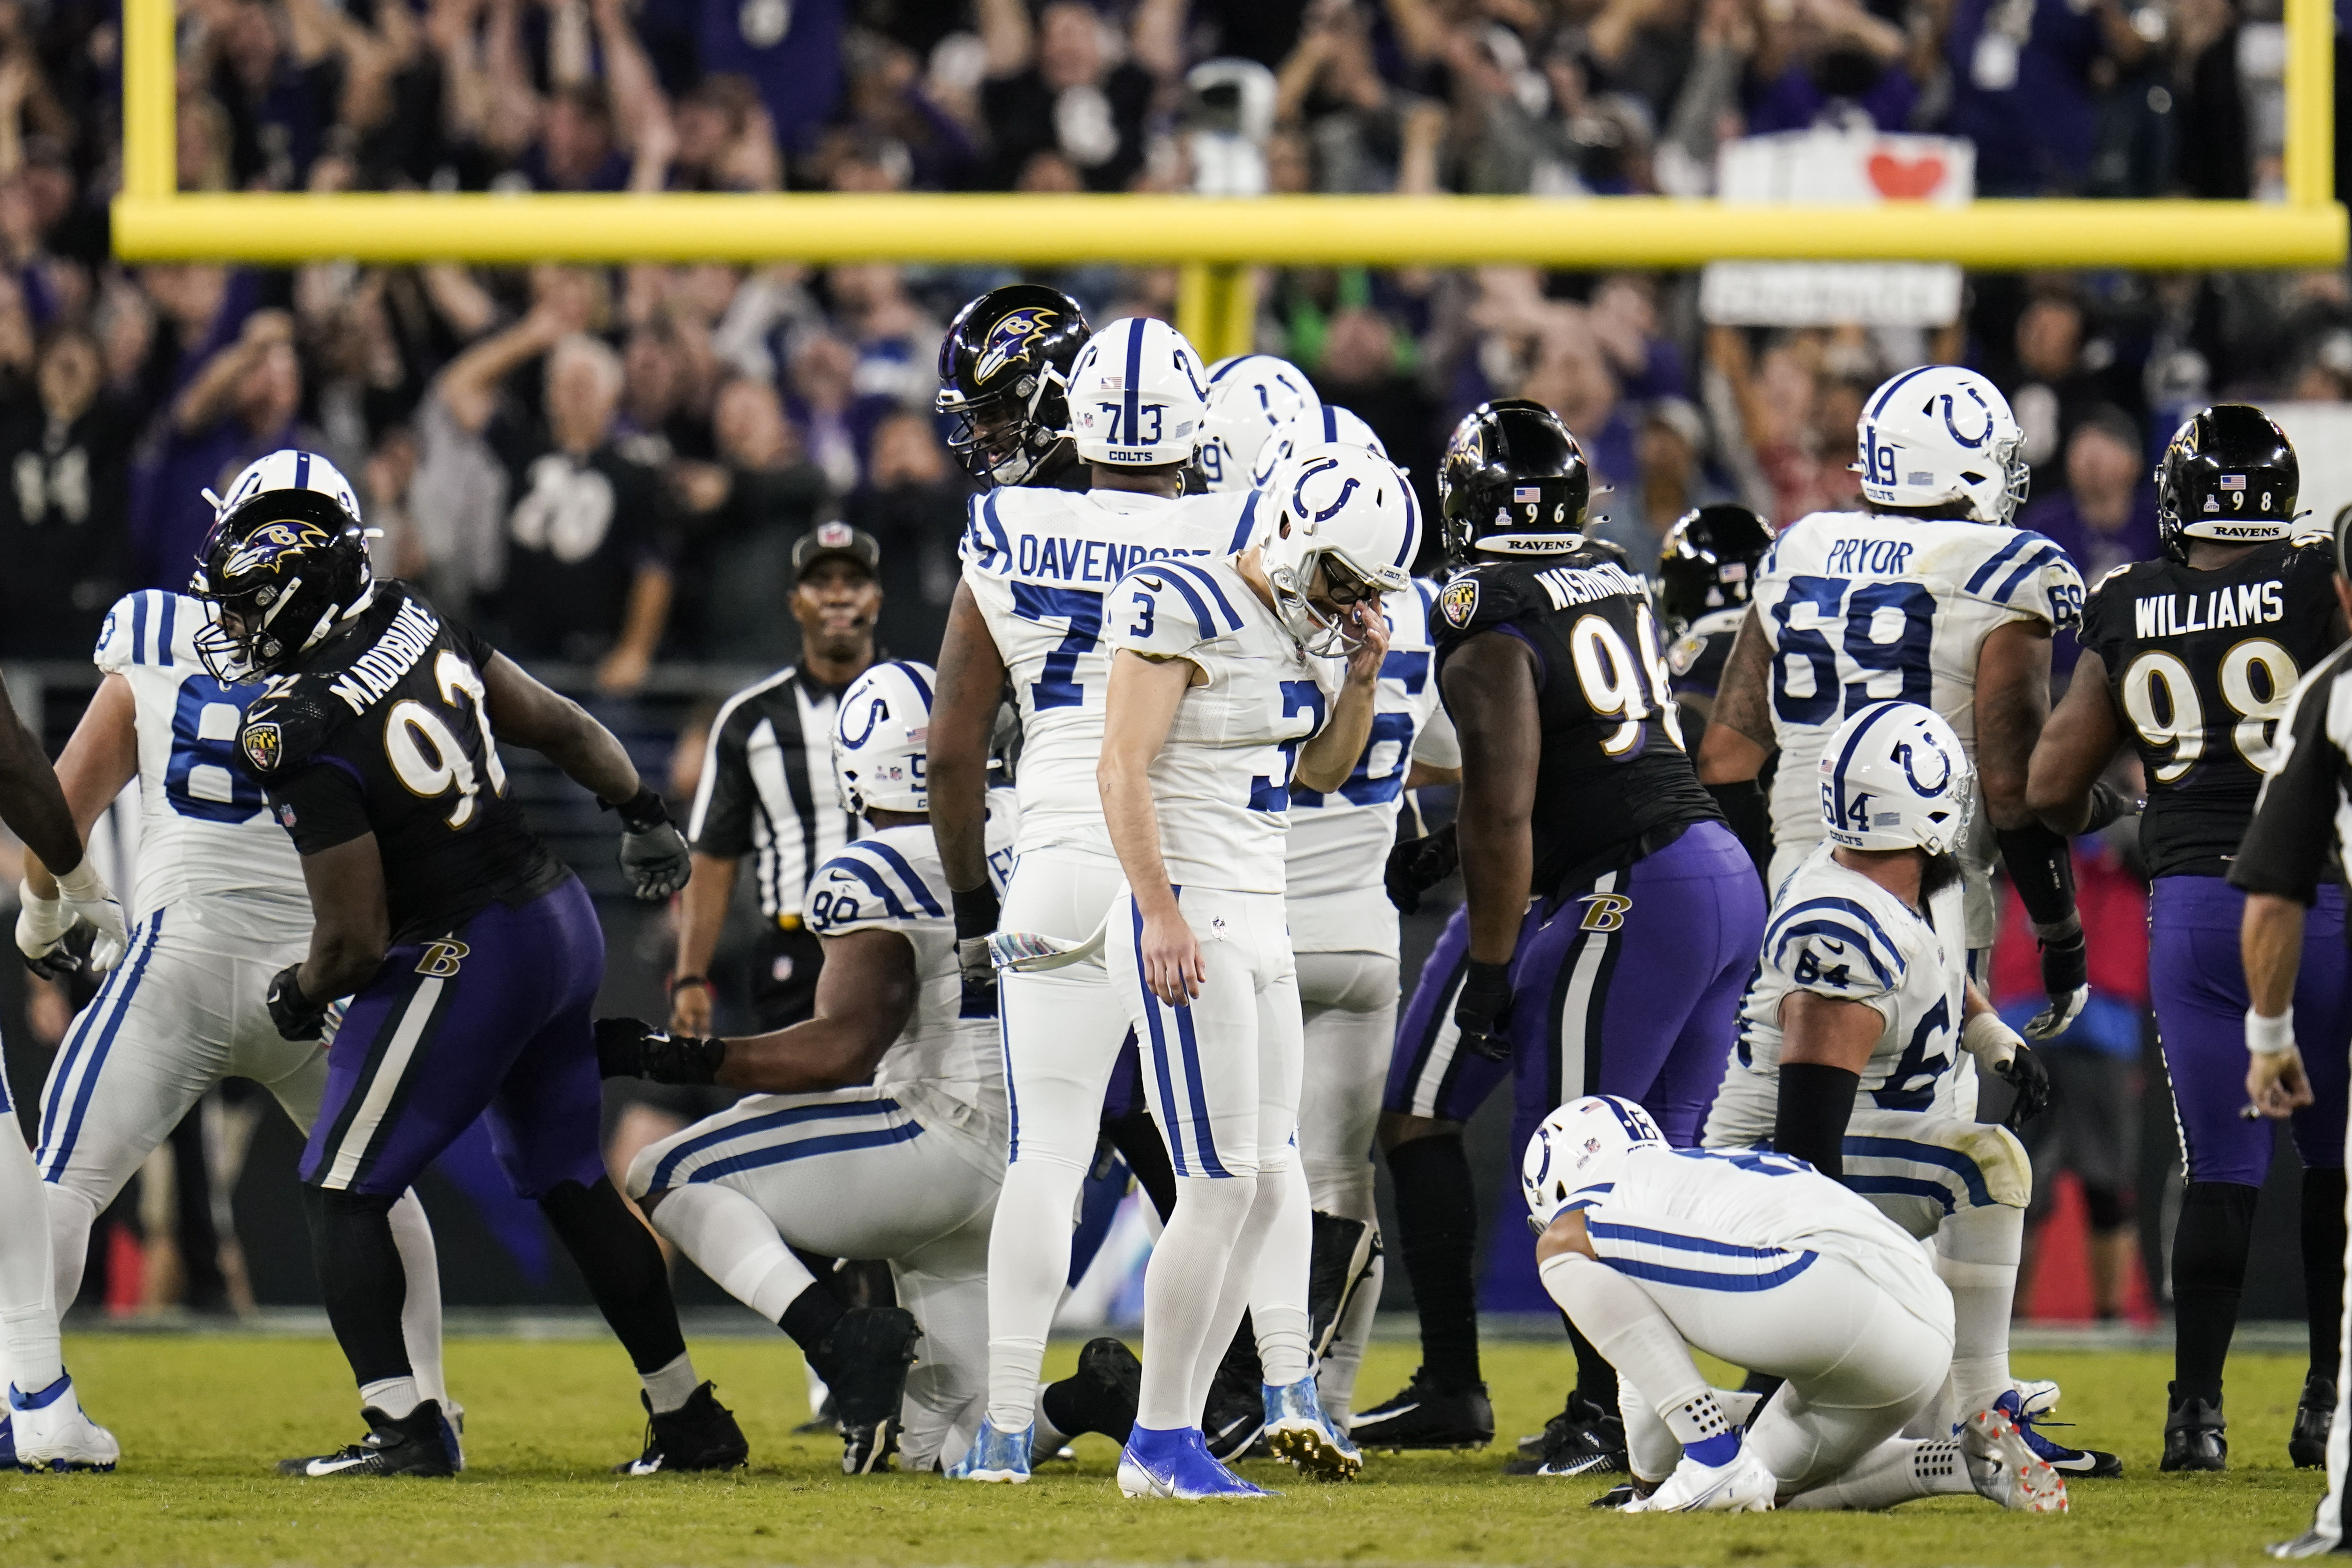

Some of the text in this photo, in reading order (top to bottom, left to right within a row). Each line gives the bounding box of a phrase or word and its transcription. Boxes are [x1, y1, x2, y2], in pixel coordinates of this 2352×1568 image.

[1109, 451, 1153, 462] COLTS
[1525, 503, 1565, 523] 96
[2232, 491, 2272, 512] 98
[1507, 540, 1574, 552] RAVENS
[2213, 526, 2280, 538] RAVENS
[1384, 569, 1401, 581] COLTS
[1826, 539, 1913, 575] PRYOR
[1130, 591, 1155, 638] 3
[2135, 580, 2284, 639] WILLIAMS
[328, 597, 439, 712] MADUBUIKE
[1768, 575, 1938, 727] 69
[2121, 637, 2302, 784] 98
[1246, 679, 1326, 812] 3
[1821, 782, 1870, 832] 64
[1829, 830, 1864, 846] COLTS
[812, 890, 860, 932] 90
[1794, 948, 1850, 990] 64
